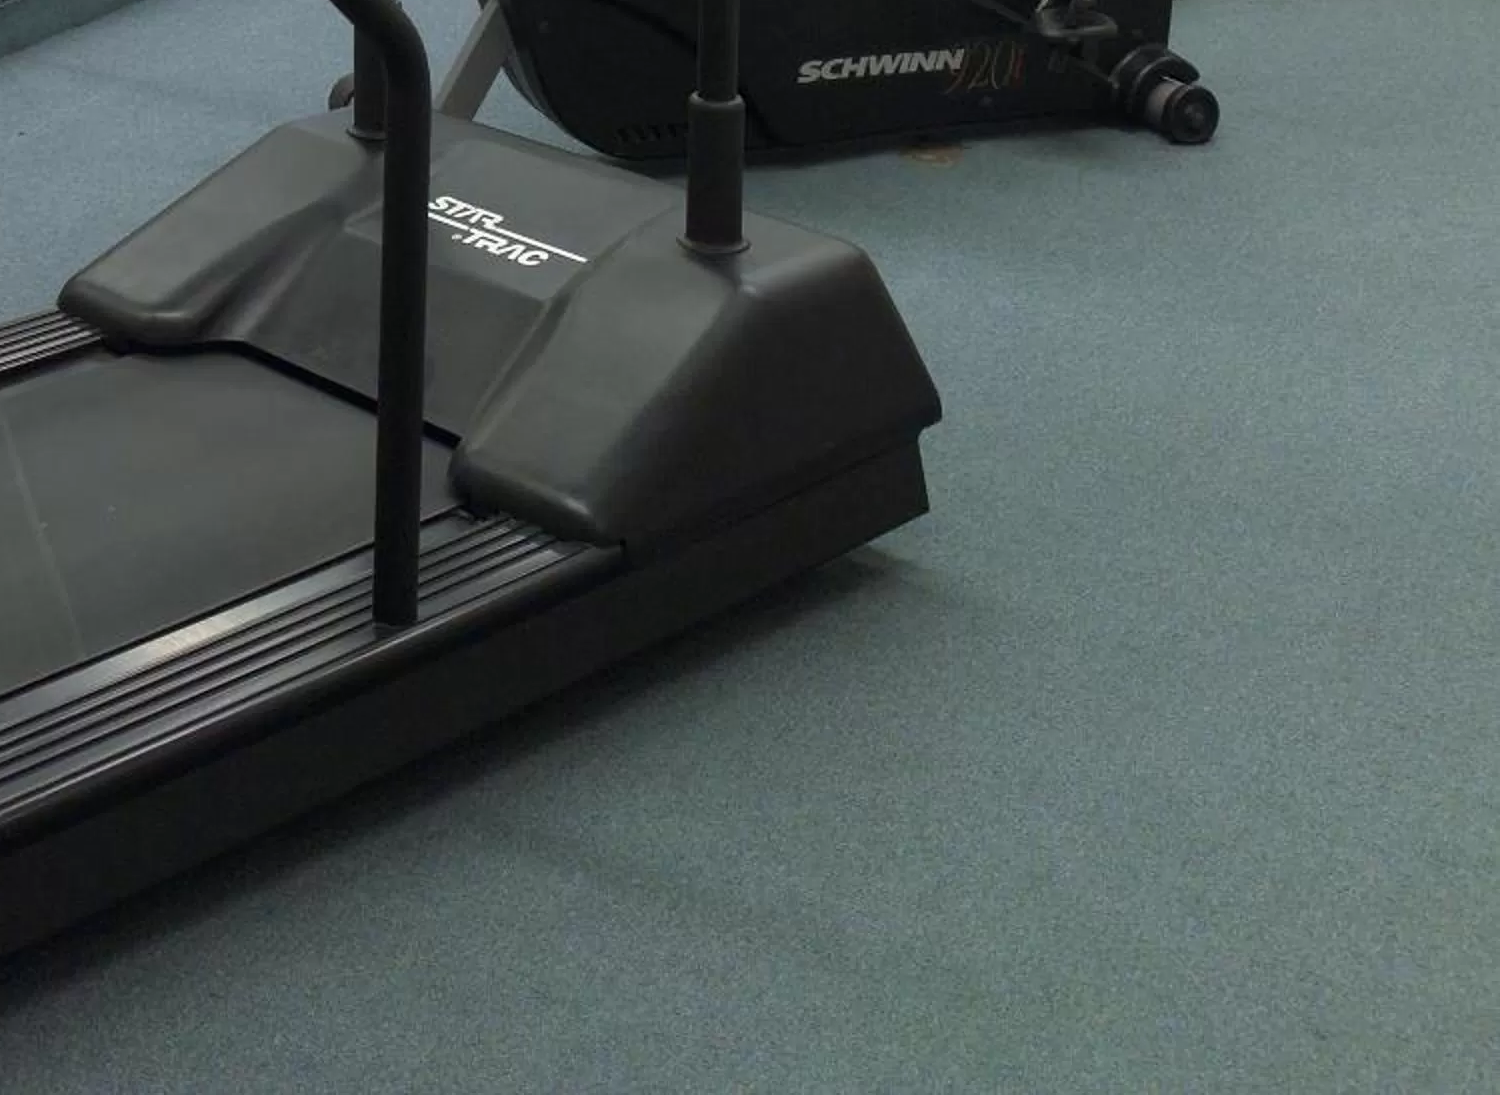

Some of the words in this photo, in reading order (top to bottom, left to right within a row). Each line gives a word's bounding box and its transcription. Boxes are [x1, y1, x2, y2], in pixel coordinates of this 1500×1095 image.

[797, 48, 965, 84] SCHWINN
[428, 195, 505, 230] STAR
[461, 228, 549, 266] TRAC
